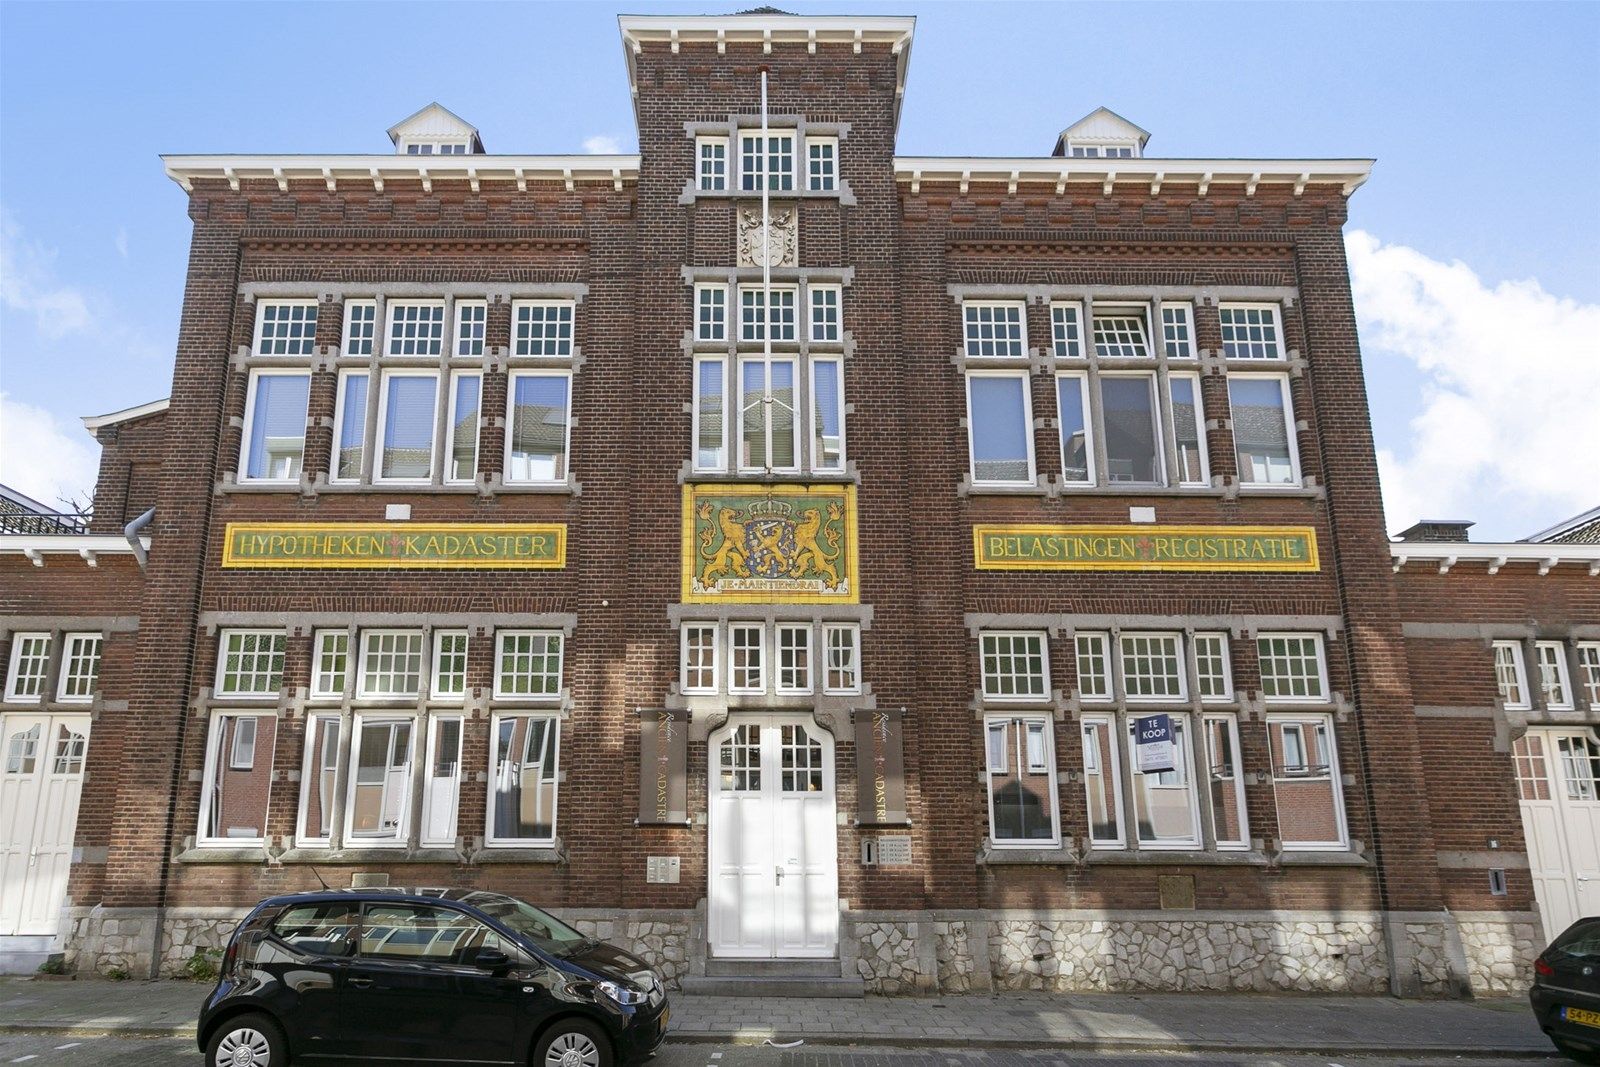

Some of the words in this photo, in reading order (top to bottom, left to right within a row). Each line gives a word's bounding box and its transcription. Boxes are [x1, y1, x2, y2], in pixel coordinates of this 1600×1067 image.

[240, 535, 385, 554] HYPOTHEKEN
[404, 535, 547, 556] KADASTER
[990, 536, 1136, 558] BELASTINGEN
[1154, 538, 1301, 559] REGISTRATIE
[1142, 729, 1166, 739] KOOP
[1148, 720, 1158, 728] TE
[657, 764, 667, 822] CADASTRE
[874, 765, 886, 822] CADASTRE
